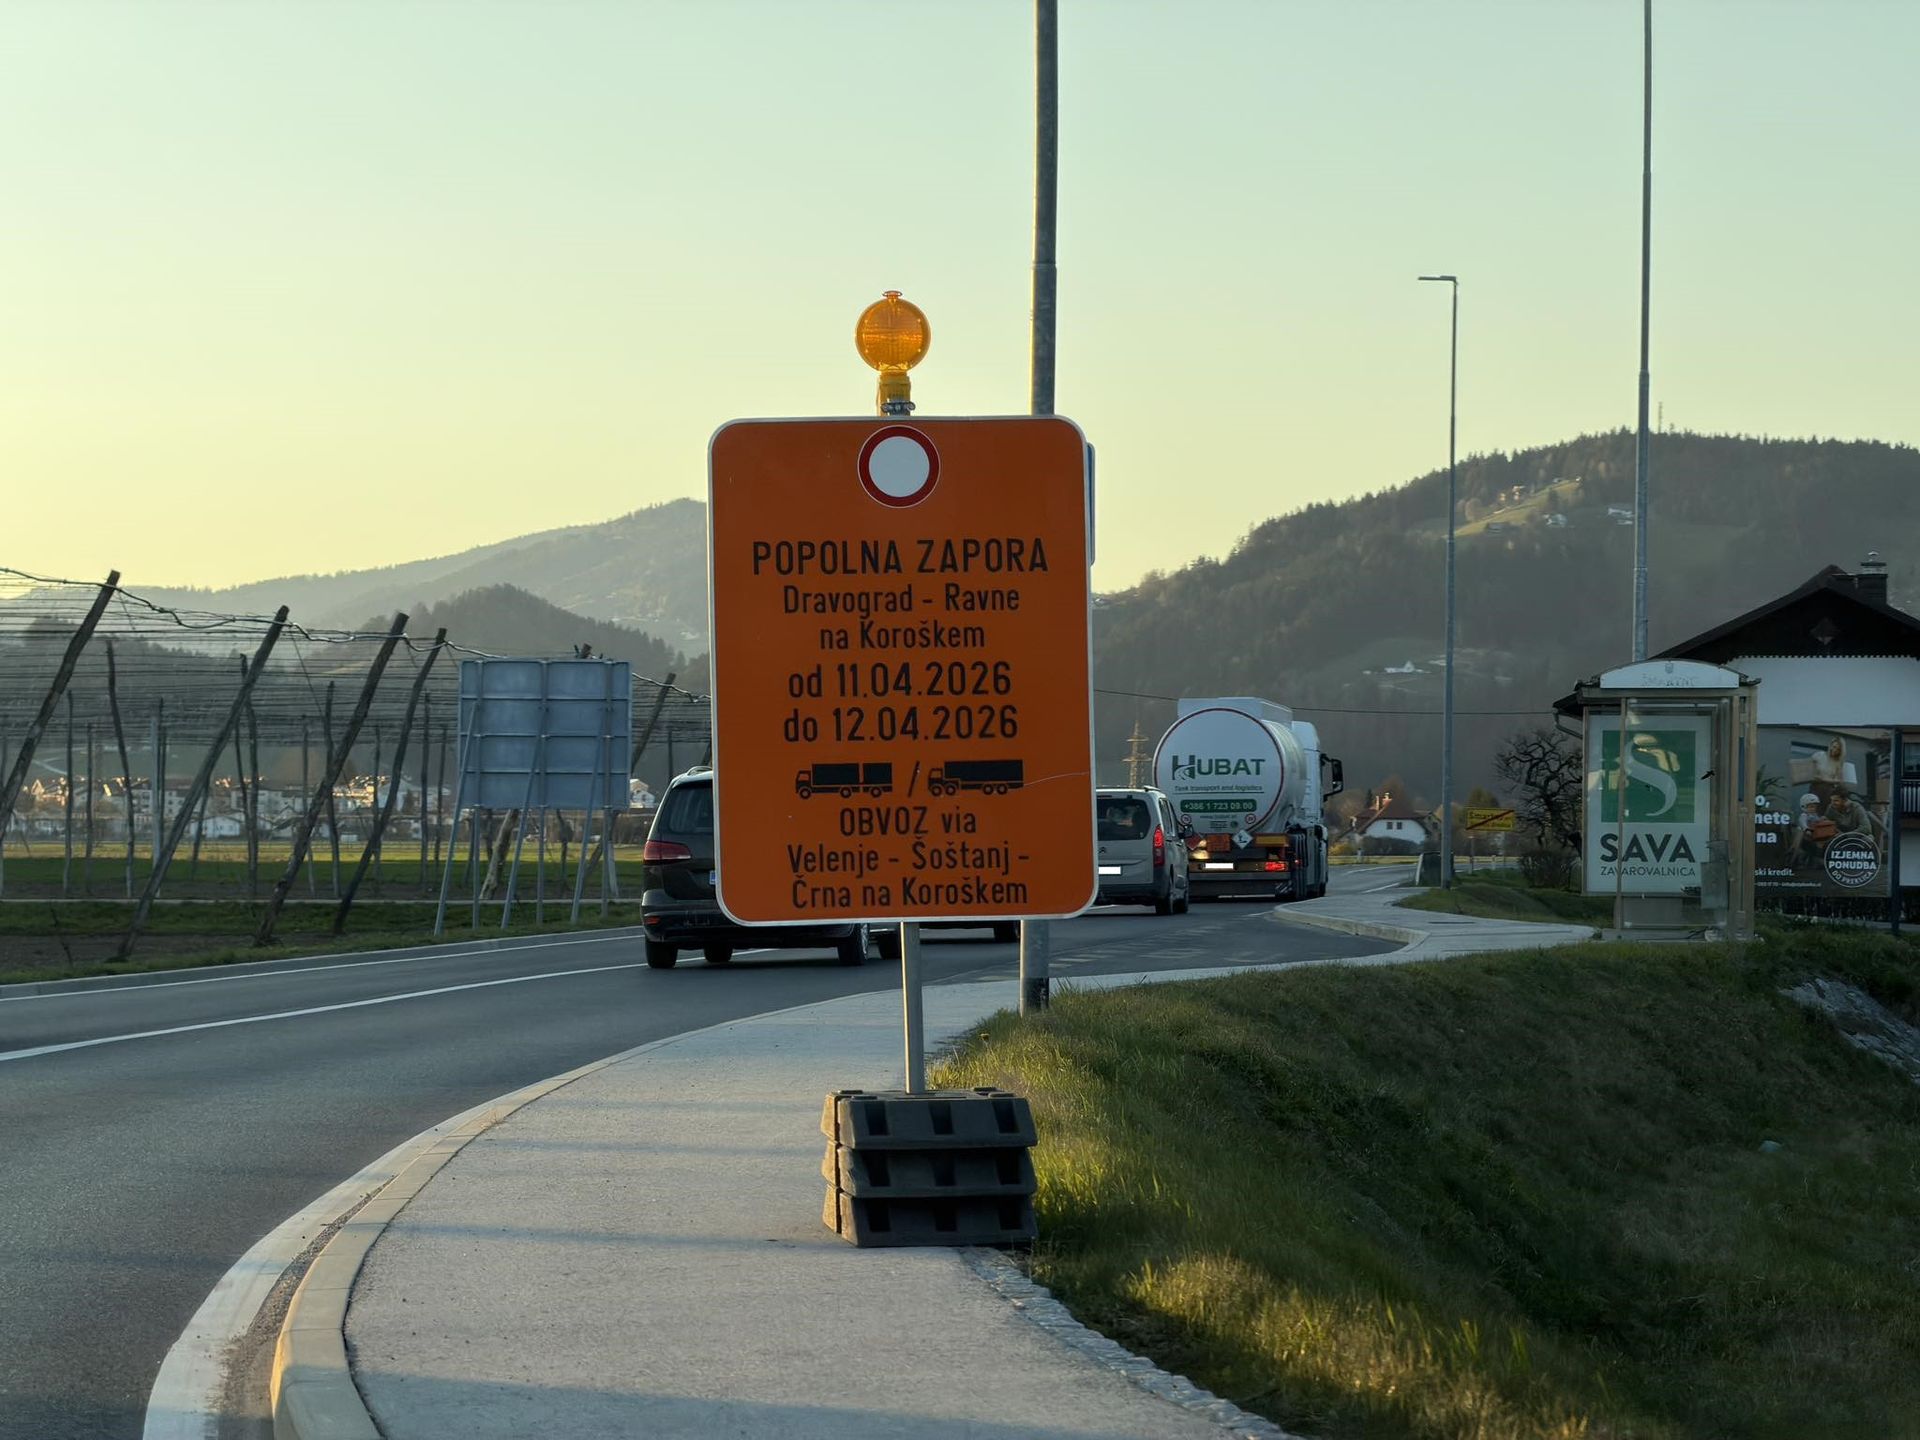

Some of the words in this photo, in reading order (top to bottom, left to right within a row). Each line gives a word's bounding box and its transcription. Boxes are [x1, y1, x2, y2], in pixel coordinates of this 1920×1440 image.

[752, 540, 903, 576] POPOLNA
[916, 537, 1049, 574] ZAPORA
[783, 584, 913, 621] Dravograd
[944, 582, 1020, 612] Ravne
[820, 628, 849, 650] na
[860, 619, 985, 650] Koroškem
[788, 663, 823, 699] od
[836, 661, 1012, 699] 11.04.2026
[783, 708, 819, 743] do
[832, 705, 1018, 743] 12.04.2026
[1172, 755, 1265, 780] HUBAT
[839, 807, 929, 837] OBVOZ
[941, 806, 977, 834] via
[787, 843, 879, 879] Velenje
[911, 836, 1010, 876] Šoštanj
[1600, 833, 1696, 862] SAVA
[1831, 850, 1875, 860] IZJEMNA
[1828, 860, 1877, 870] PONUDBA
[792, 873, 851, 910] Črna
[862, 885, 891, 907] na
[902, 876, 1028, 906] Koroškem
